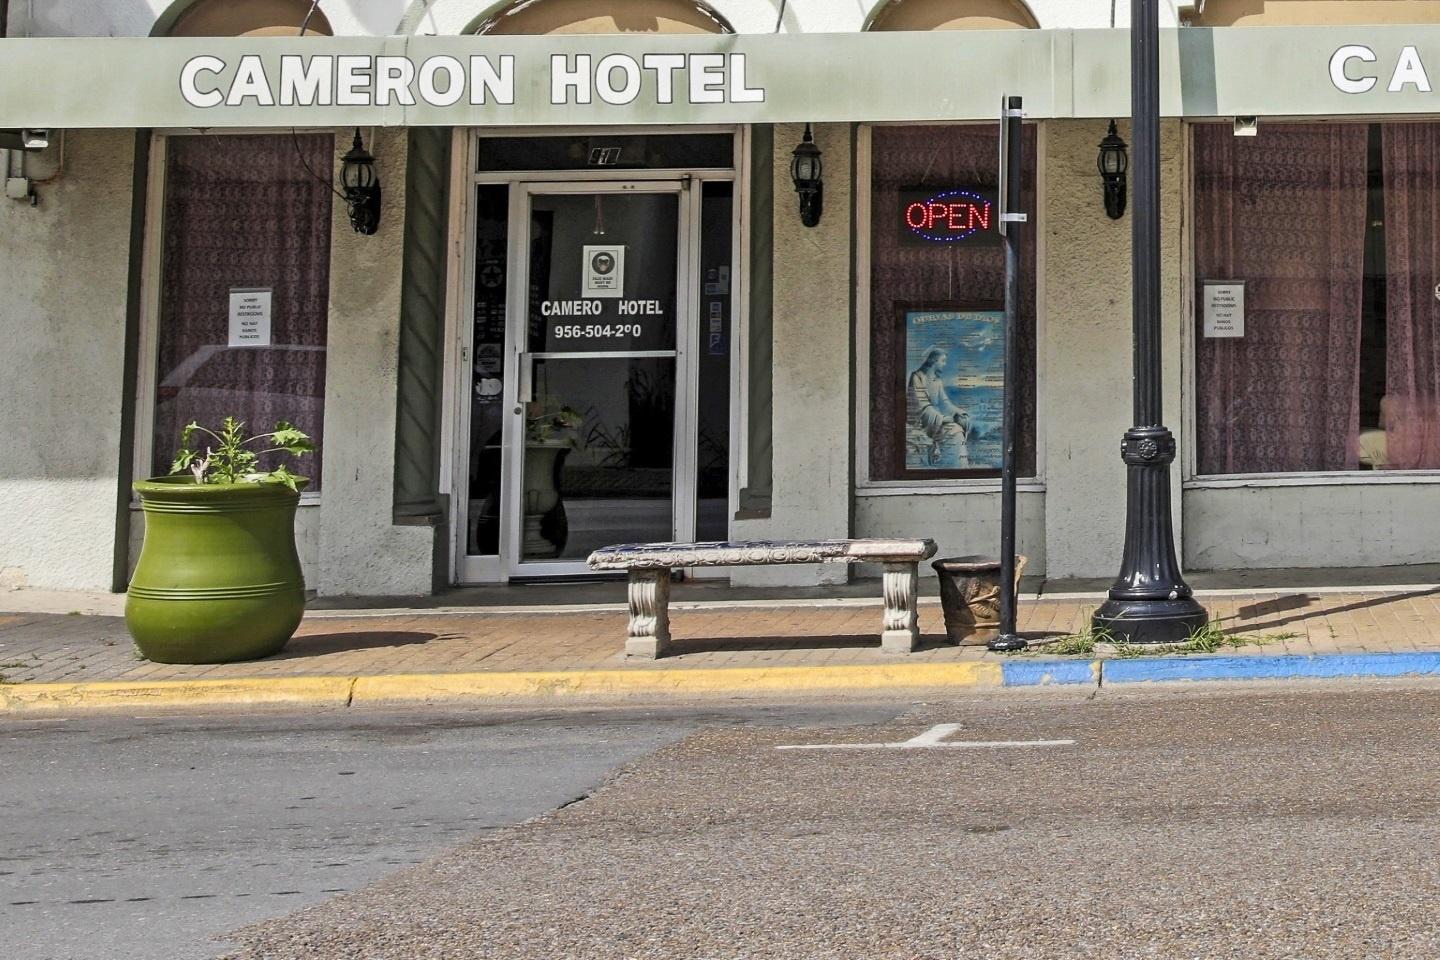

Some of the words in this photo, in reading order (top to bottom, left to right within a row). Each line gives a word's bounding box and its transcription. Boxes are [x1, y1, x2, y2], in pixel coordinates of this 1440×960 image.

[179, 54, 515, 108] CAMERON
[549, 52, 765, 105] HOTEL
[906, 202, 989, 229] OPEN
[541, 300, 602, 316] CAMERO
[618, 300, 663, 315] HOTEL
